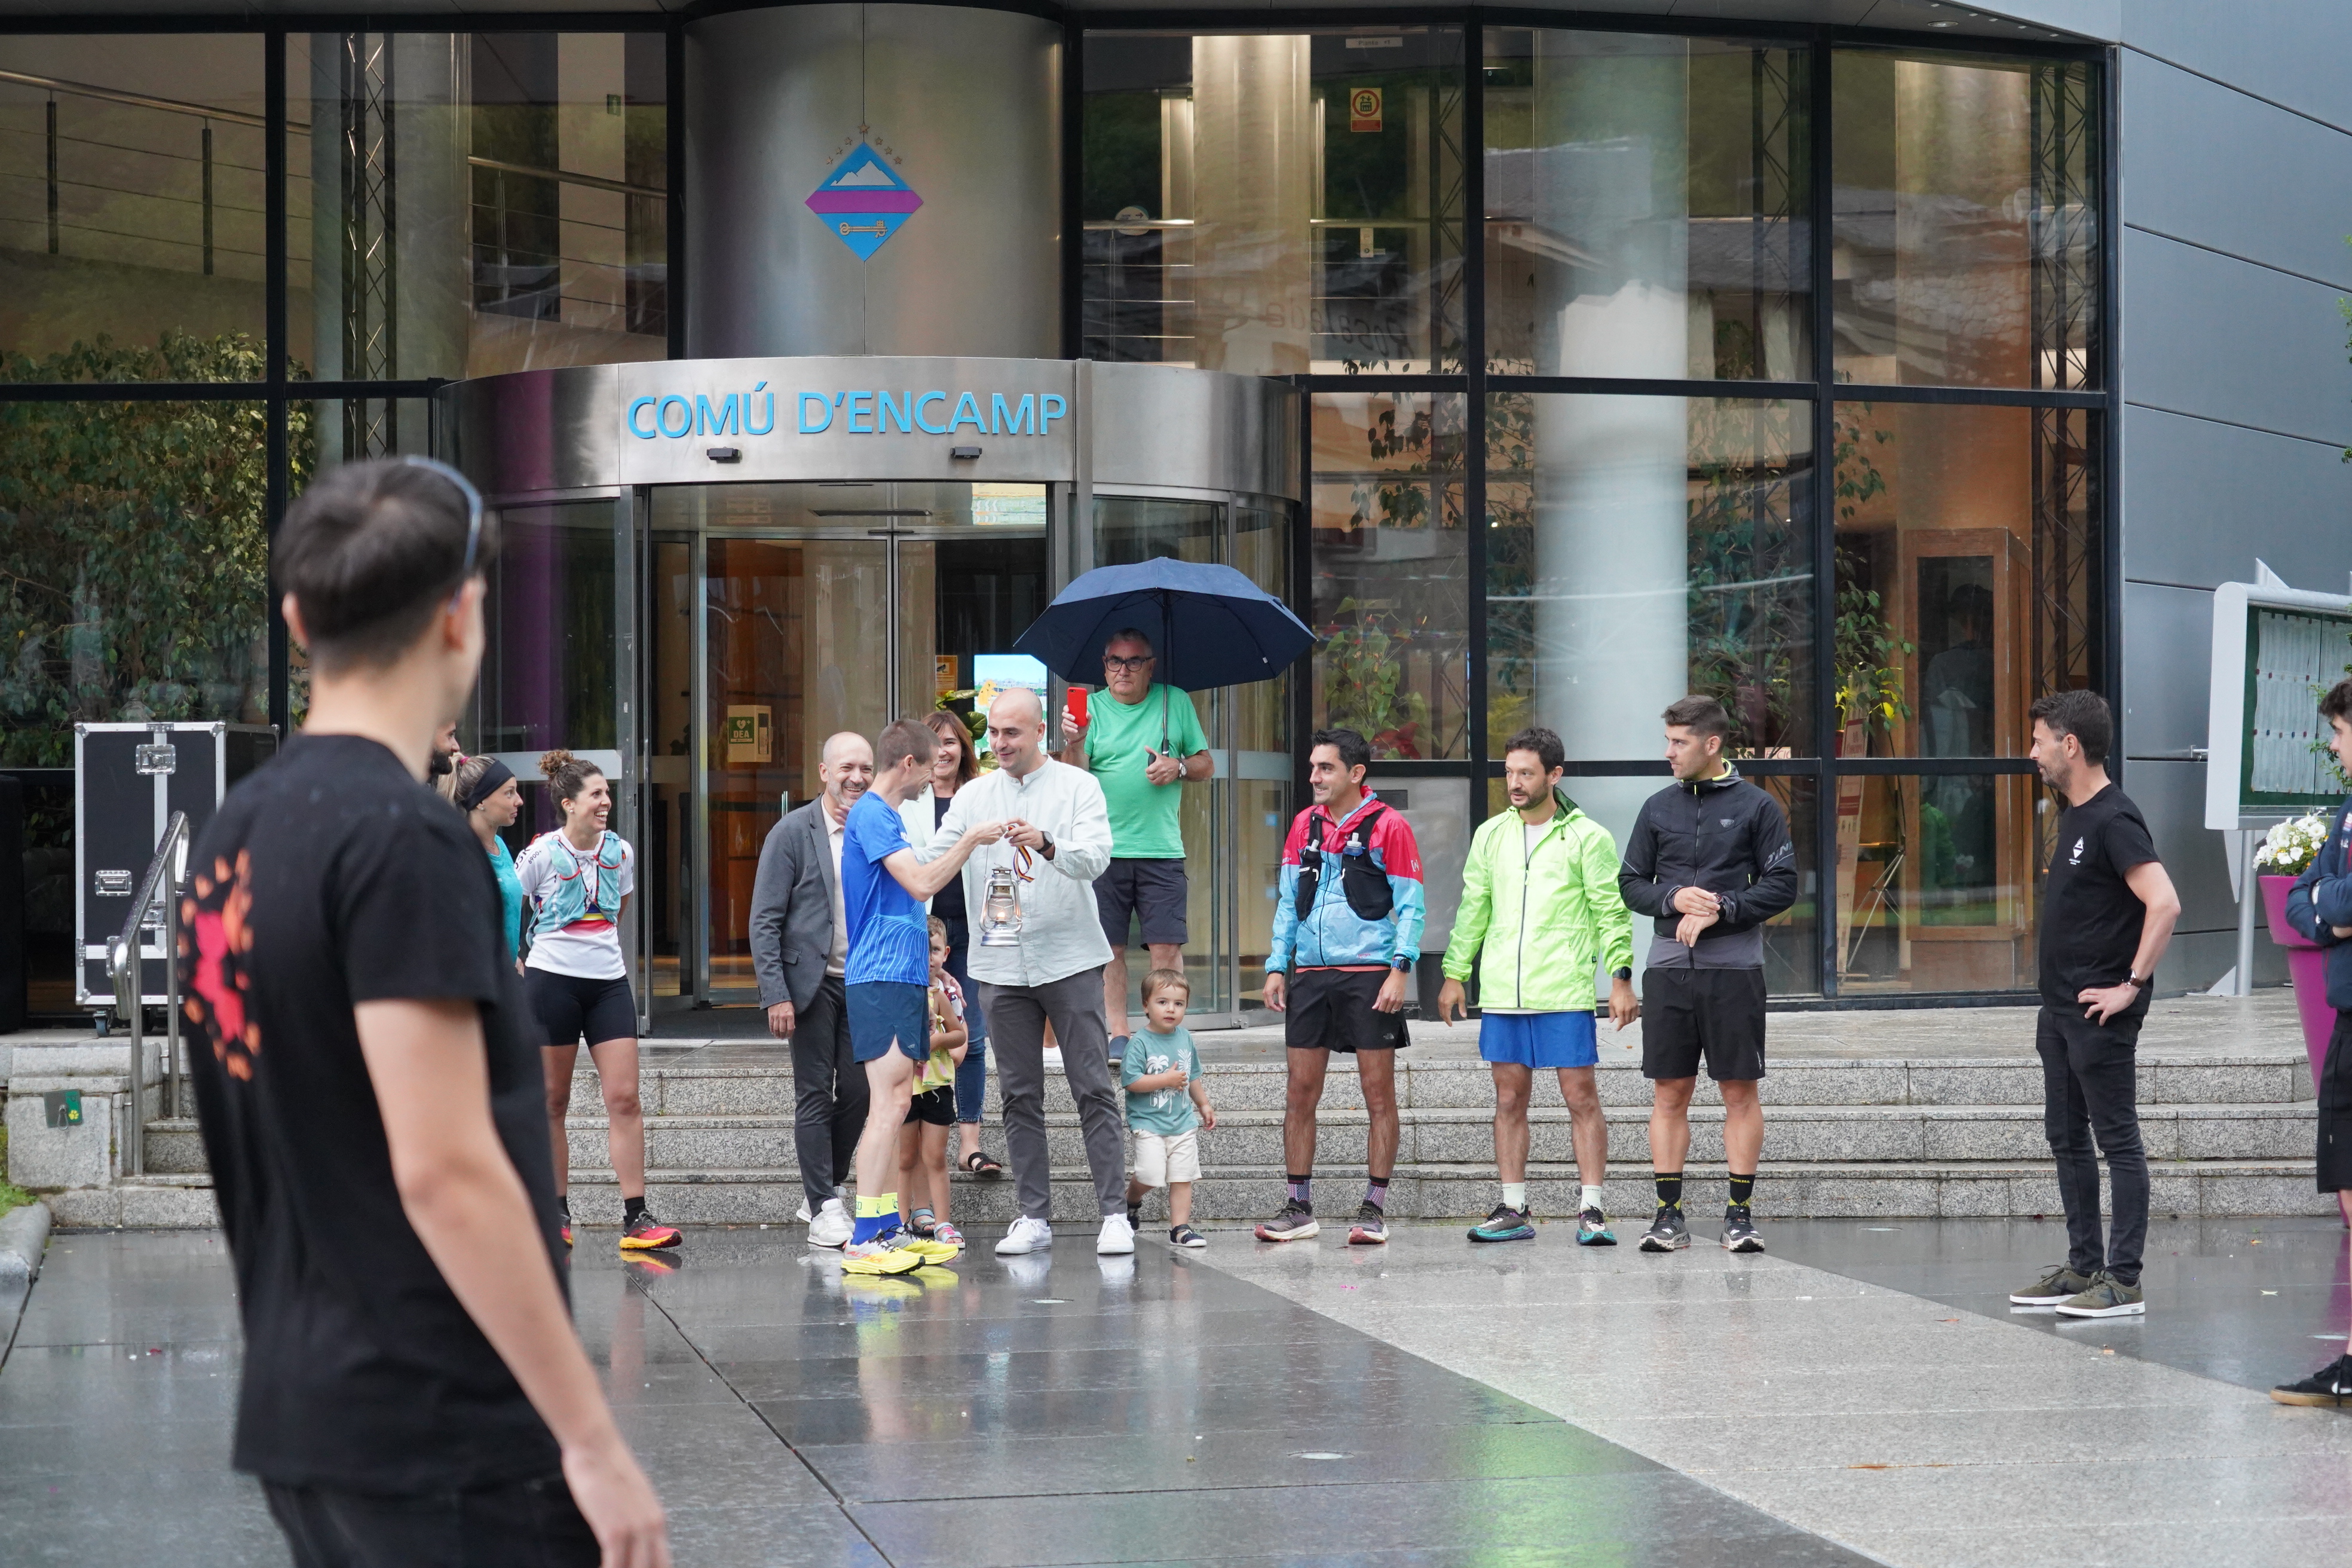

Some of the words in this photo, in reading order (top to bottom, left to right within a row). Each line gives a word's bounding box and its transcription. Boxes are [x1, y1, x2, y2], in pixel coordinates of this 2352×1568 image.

[627, 381, 774, 439] COMÚ
[798, 390, 1067, 436] D'ENCAMP
[733, 730, 750, 739] DEA
[846, 1251, 883, 1263] ALTRA
